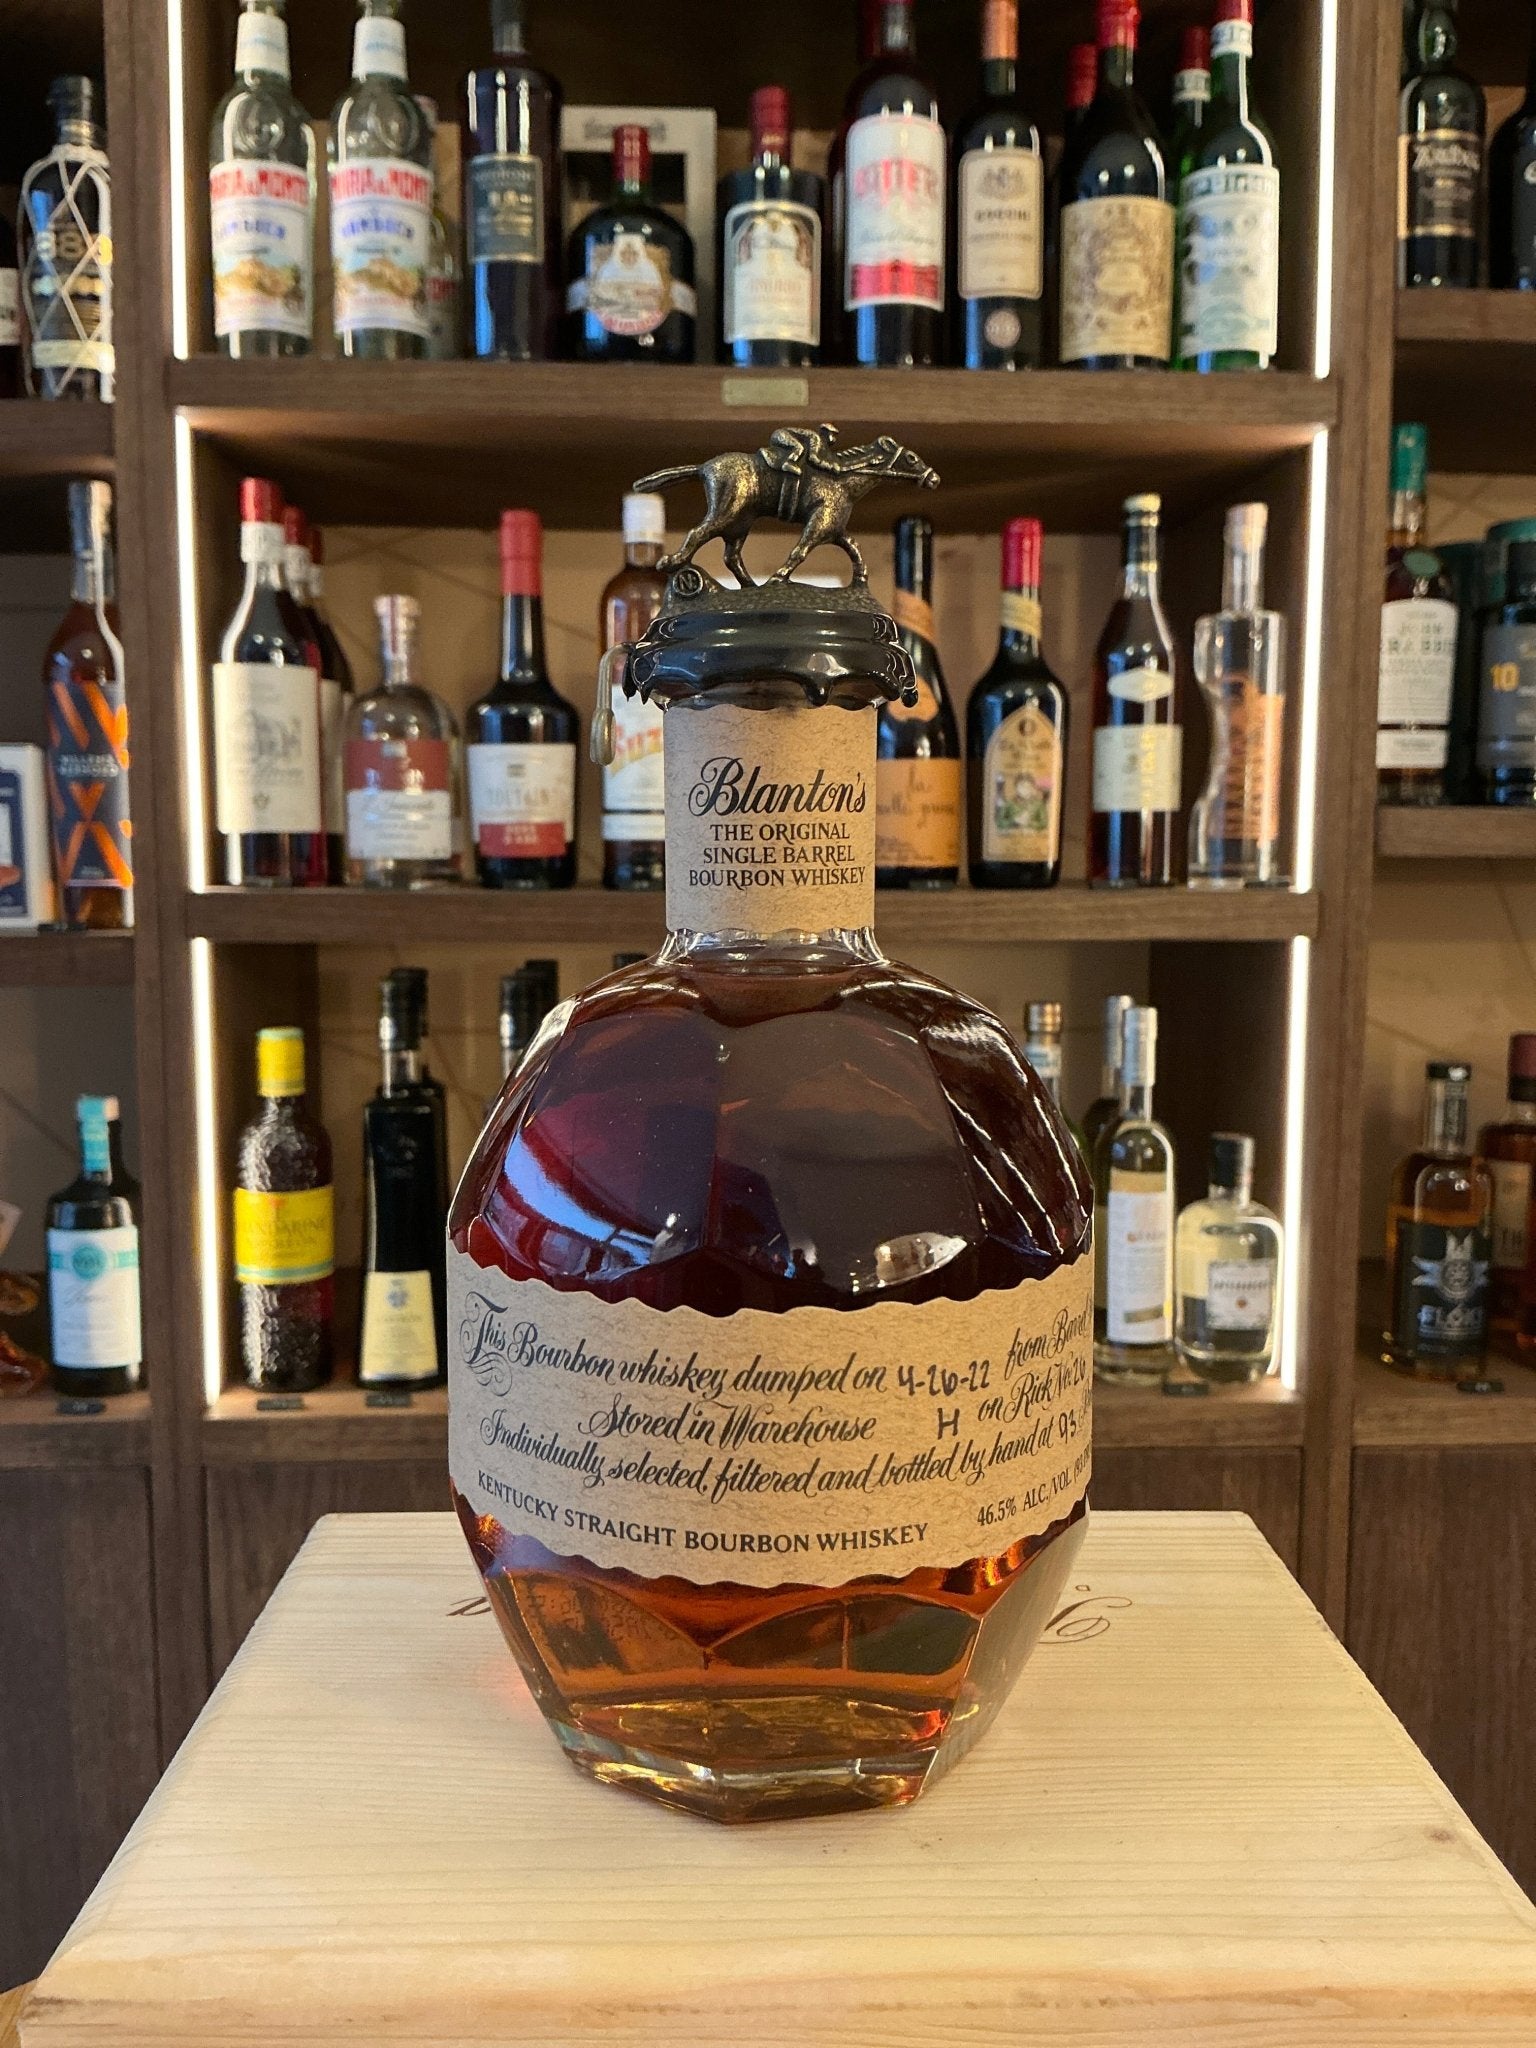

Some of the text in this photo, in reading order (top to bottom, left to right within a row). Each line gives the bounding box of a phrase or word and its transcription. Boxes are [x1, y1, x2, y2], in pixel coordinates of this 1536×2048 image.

[1491, 662, 1521, 692] 10
[688, 757, 866, 817] Blanton's
[710, 823, 850, 845] THE ORIGINAL
[703, 845, 856, 867] SINGLE BARREL
[688, 866, 866, 891] BOURBON WHISKEY
[460, 1291, 511, 1384] This
[507, 1322, 616, 1385] Bourbon
[617, 1349, 729, 1400] whiskey
[730, 1352, 857, 1404] dumped
[852, 1366, 888, 1393] on
[898, 1359, 990, 1397] 4-26-22
[1005, 1327, 1048, 1381] from
[977, 1396, 1004, 1421] on
[1003, 1367, 1054, 1423] Rick
[578, 1393, 692, 1444] Stored
[685, 1410, 715, 1446] in
[693, 1400, 878, 1451] Warehouse
[937, 1407, 961, 1440] H
[480, 1409, 605, 1489] Individually
[607, 1451, 713, 1496] selected,
[710, 1457, 821, 1504] filtered
[817, 1453, 880, 1494] and
[874, 1441, 961, 1489] bottled
[958, 1439, 987, 1487] by
[987, 1418, 1041, 1468] hand
[1038, 1416, 1056, 1449] at
[1058, 1409, 1077, 1445] 93
[477, 1469, 929, 1554] KENTUCKY STRAIGHT BOURBON WHISKEY
[976, 1495, 1018, 1527] 46.5%
